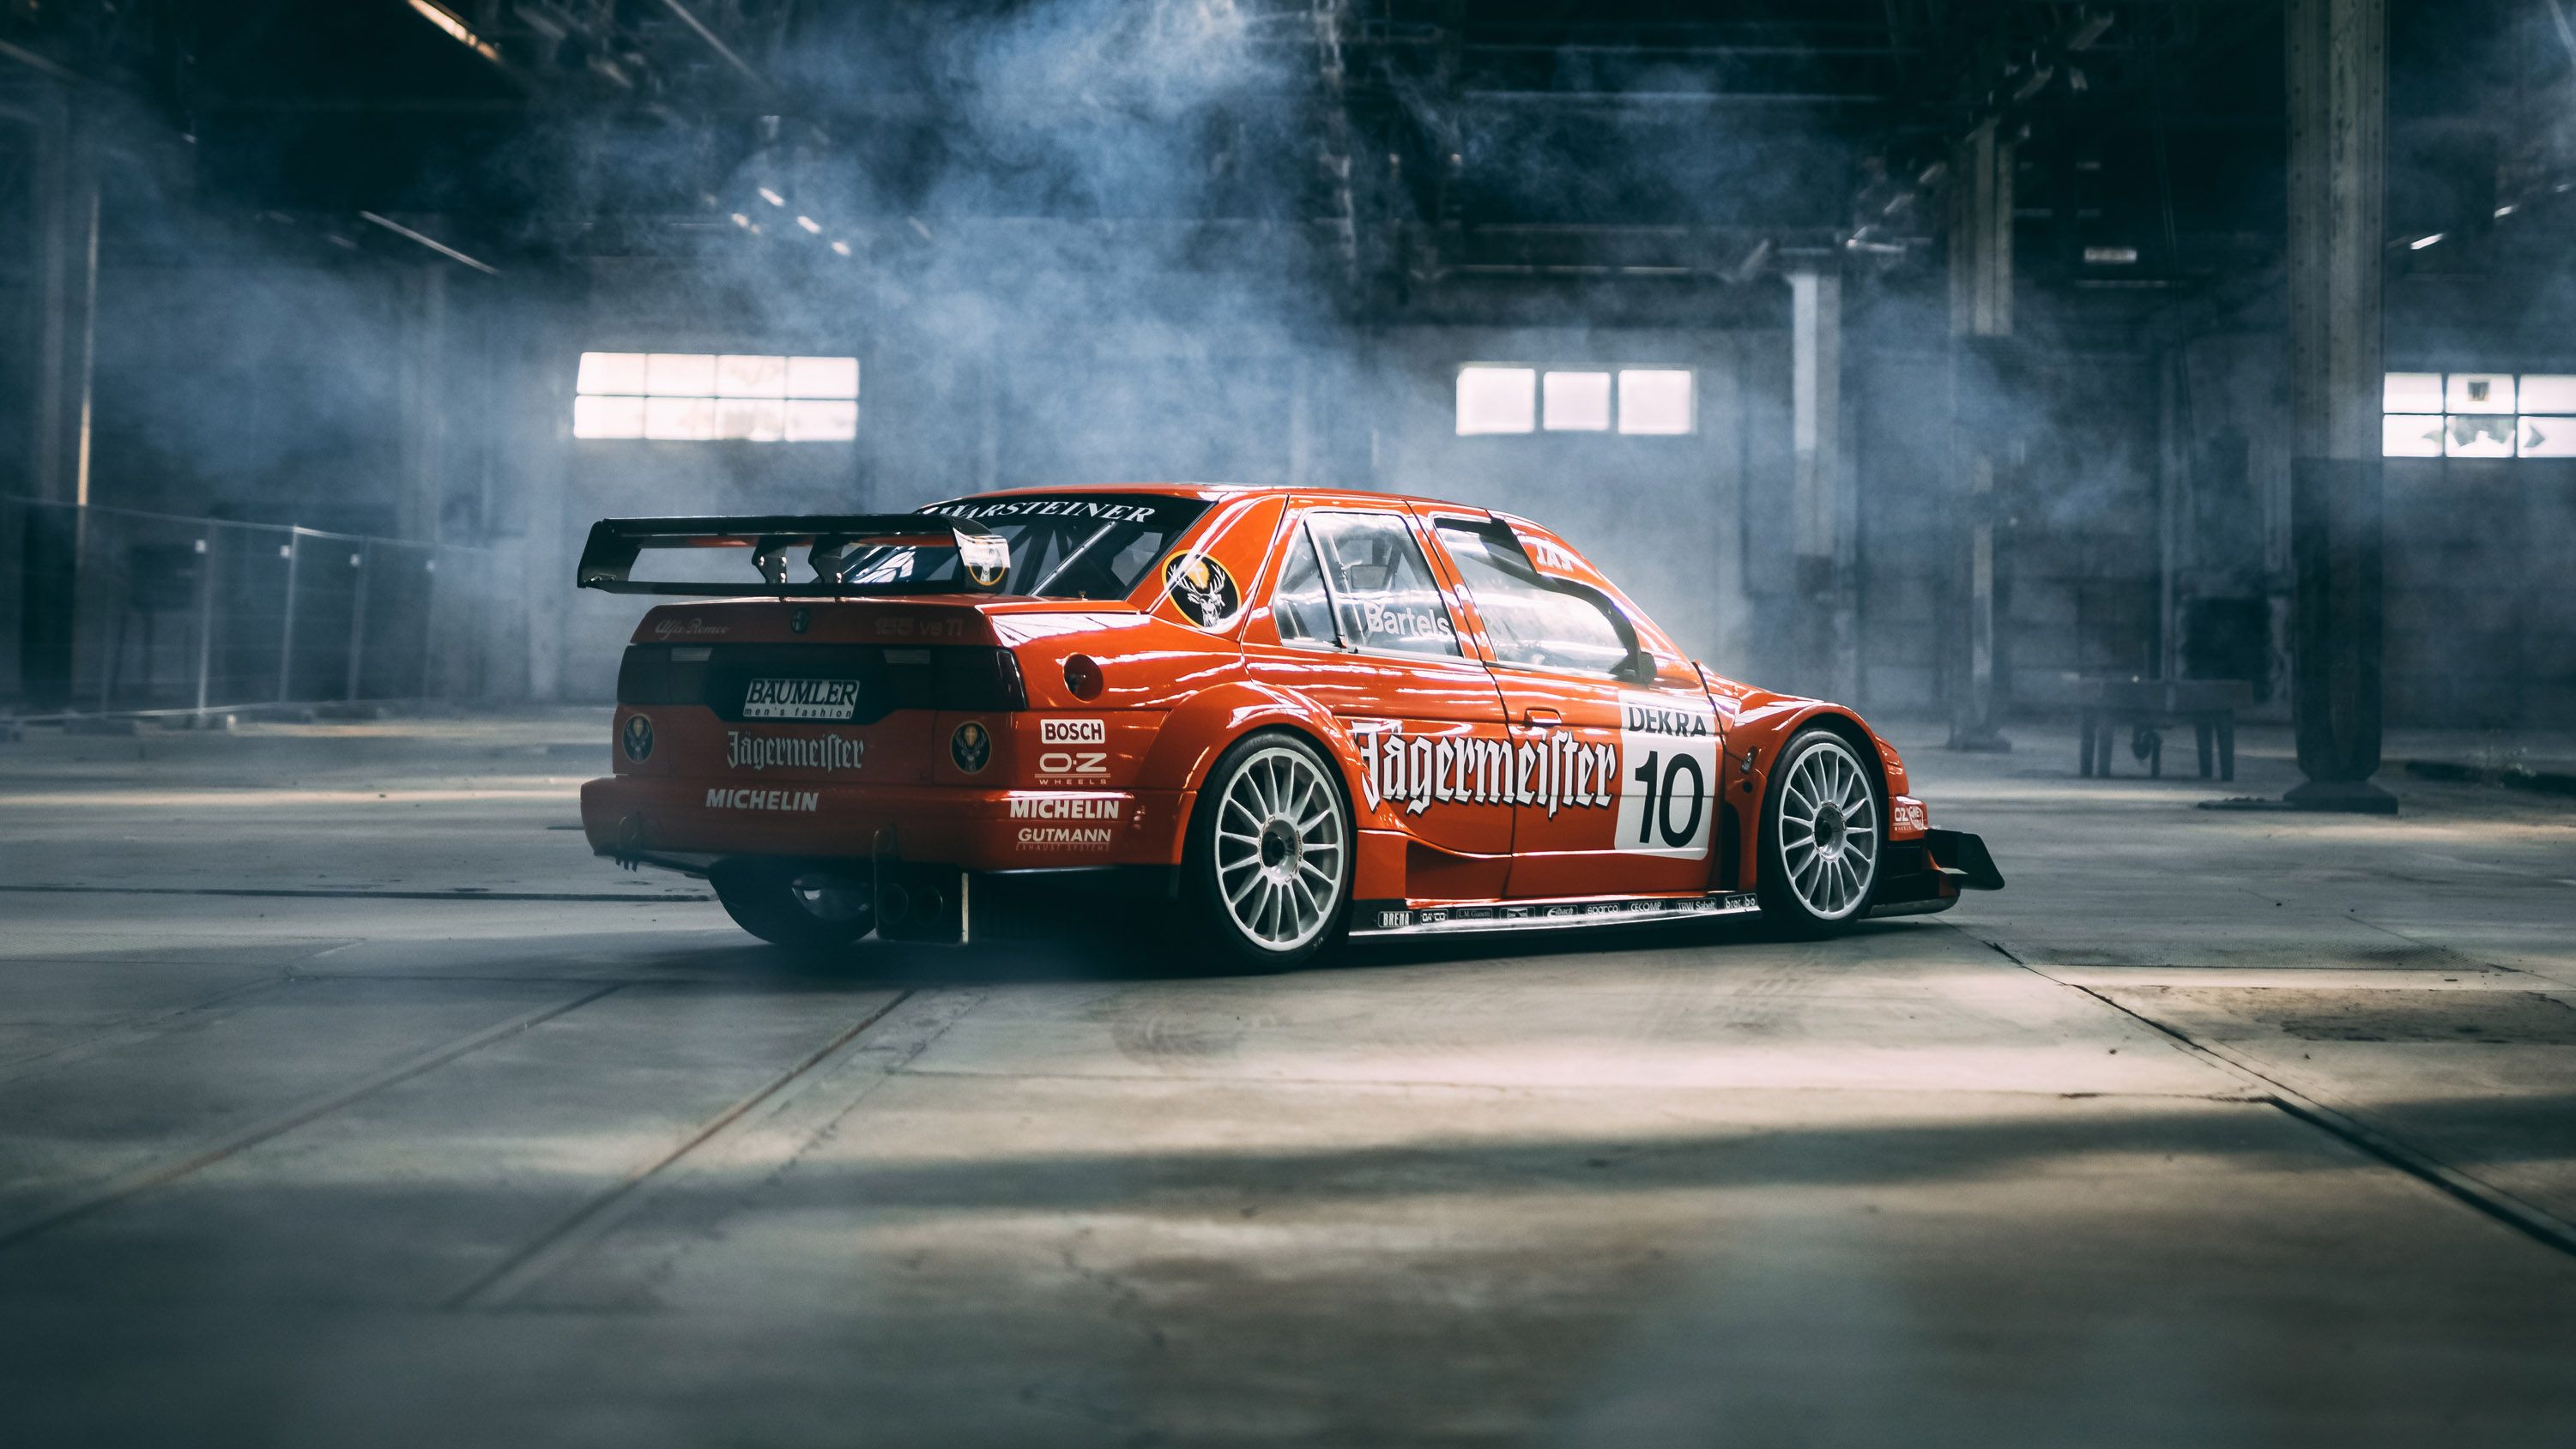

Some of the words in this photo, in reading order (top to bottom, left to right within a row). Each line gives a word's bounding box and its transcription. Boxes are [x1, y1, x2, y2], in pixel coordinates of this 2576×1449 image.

[1364, 601, 1453, 637] Bartels
[655, 619, 686, 641] Alfa
[686, 618, 729, 634] Romeo
[744, 707, 785, 716] men's
[795, 707, 852, 718] fashion
[1628, 703, 1707, 738] DEKRA
[1044, 722, 1103, 740] BOSCH
[705, 788, 819, 812] MICHELIN
[1009, 799, 1119, 818] MICHELIN
[1635, 751, 1704, 848] 10
[1018, 828, 1112, 842] GUTMANN
[1067, 843, 1110, 852] SYSTEMS
[1587, 904, 1618, 915] sparco
